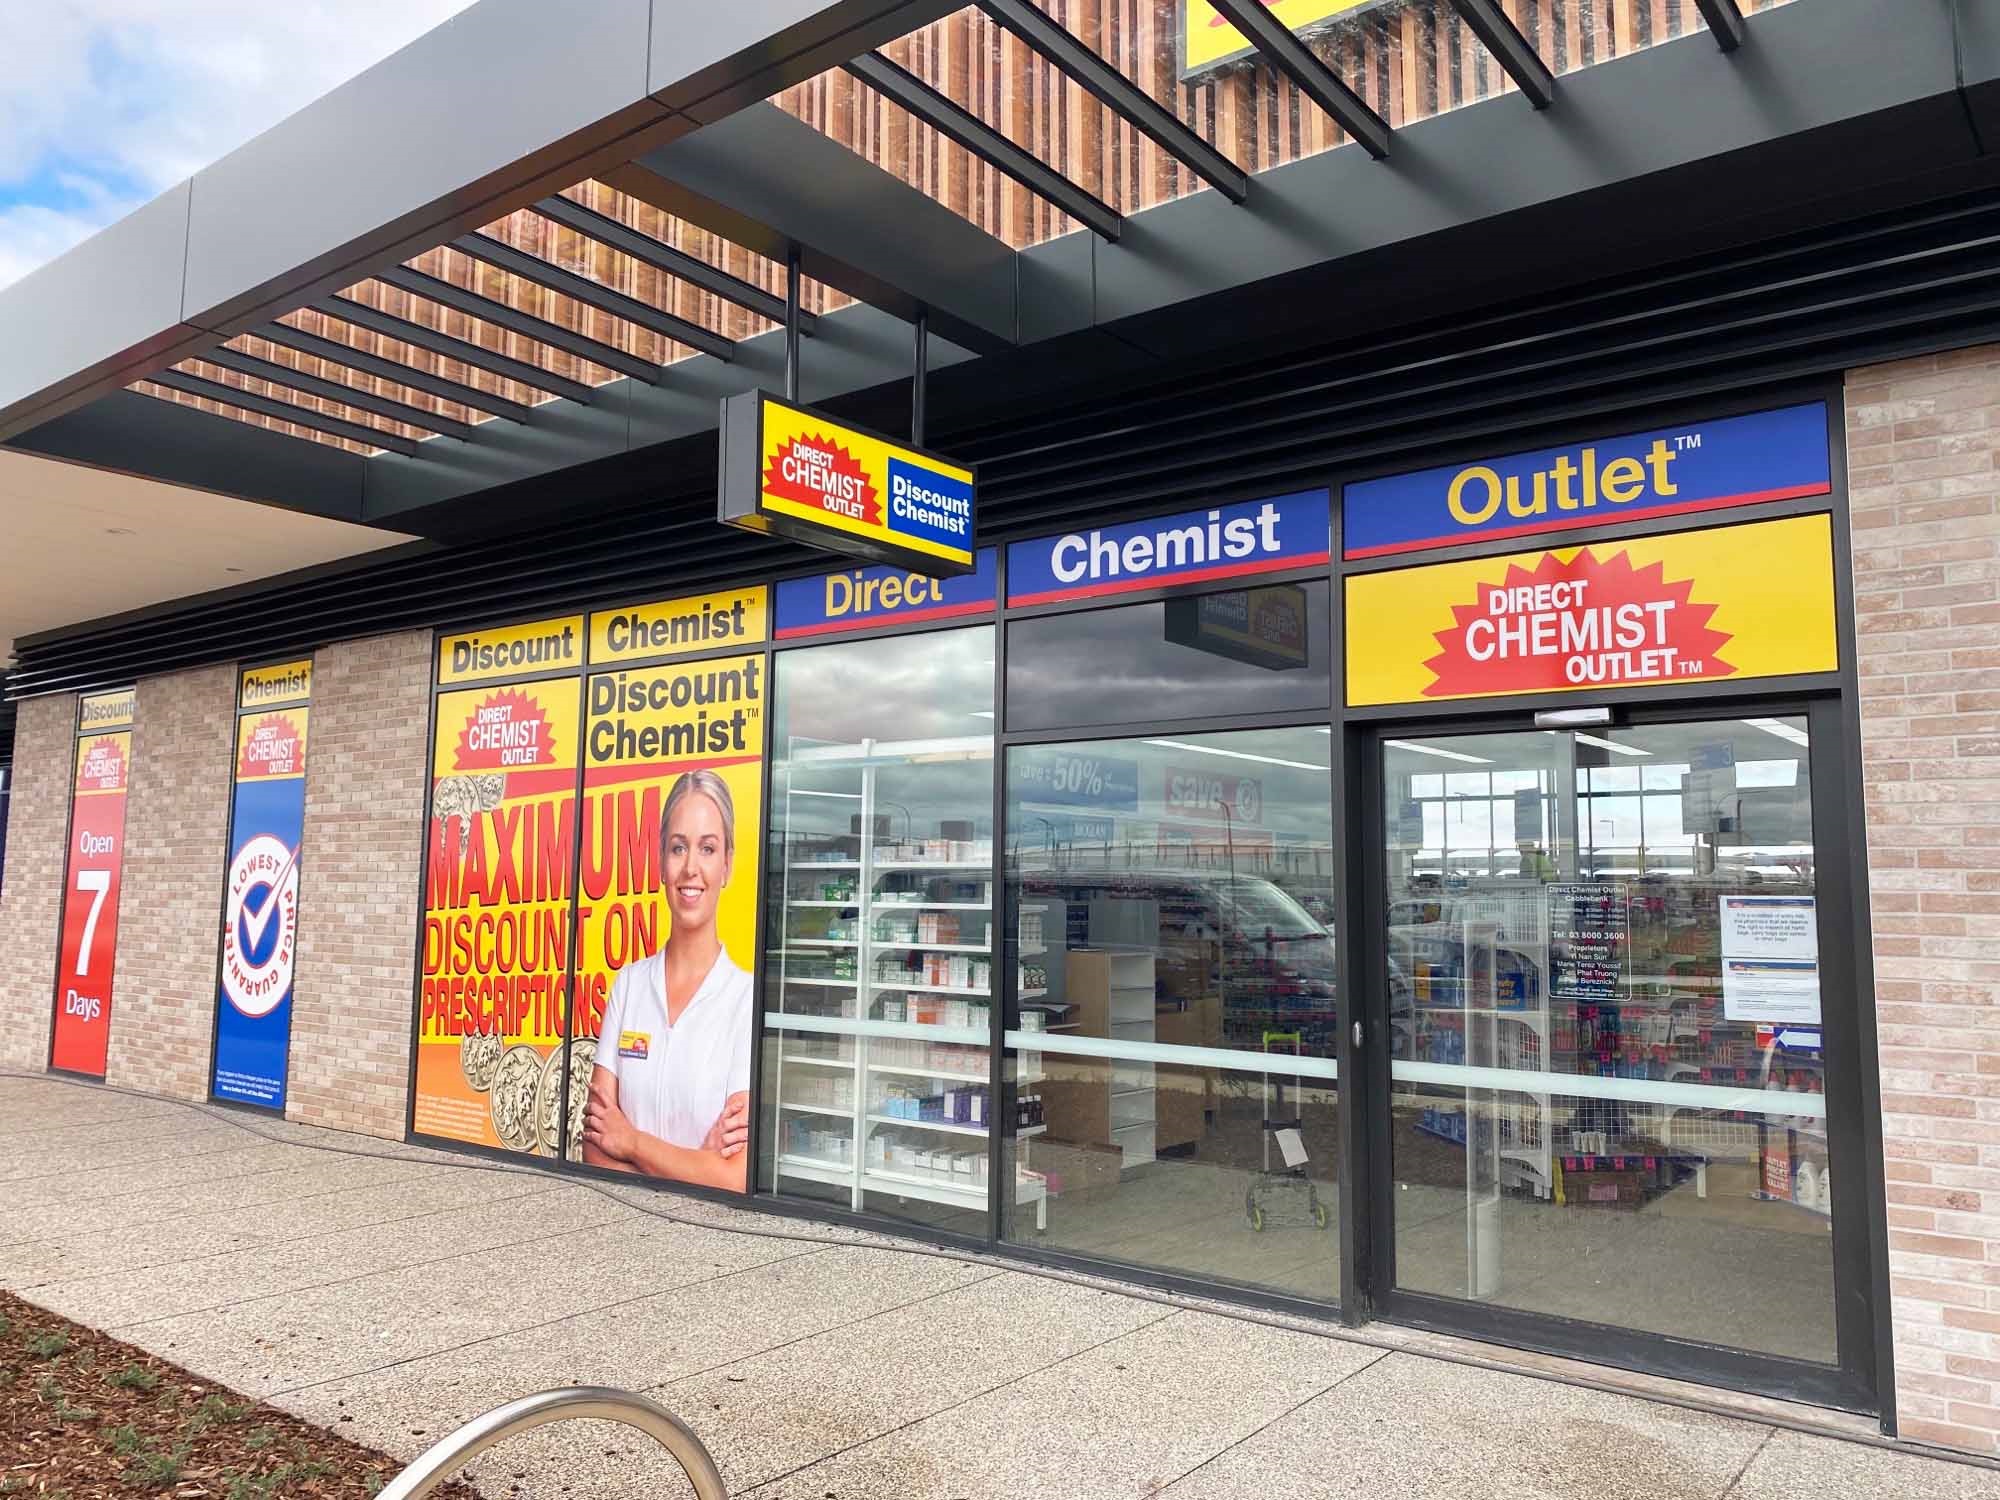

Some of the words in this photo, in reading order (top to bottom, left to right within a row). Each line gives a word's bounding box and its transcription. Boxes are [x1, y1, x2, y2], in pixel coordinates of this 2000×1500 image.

[793, 442, 834, 469] DIRECT
[782, 456, 865, 502] CHEMIST
[893, 474, 970, 517] Discount
[1447, 439, 1678, 526] Outlet
[823, 495, 865, 520] OUTLET
[893, 496, 965, 535] Chemist
[1051, 503, 1281, 583] Chemist
[1489, 579, 1589, 616] DIRECT
[607, 600, 745, 652] Chemist
[1465, 600, 1676, 662] CHEMIST
[453, 626, 573, 674] Discount
[1565, 648, 1678, 683] OUTLET
[244, 669, 307, 699] Chemist
[591, 659, 759, 717] Discount
[255, 726, 279, 741] DIRECT
[478, 704, 513, 724] DIRECT
[248, 738, 295, 762] CHEMIST
[469, 719, 540, 751] CHEMIST
[590, 709, 747, 762] Chemist
[84, 758, 120, 778] CHEMIST
[268, 760, 294, 774] OUTLET
[501, 746, 539, 766] OUTLET
[1052, 756, 1102, 796] 50%
[80, 831, 114, 858] Open
[426, 786, 663, 911] MAXIMUM
[232, 854, 281, 896] LOWEST
[75, 870, 112, 976] 7
[279, 889, 295, 966] PRICE
[423, 905, 593, 976] DISCOUNT
[604, 902, 658, 971] ON
[223, 921, 279, 997] GUARANTEE
[1568, 944, 1608, 953] Proprietors
[65, 989, 101, 1022] Days
[421, 971, 608, 1040] PRESCRIPTIONS
